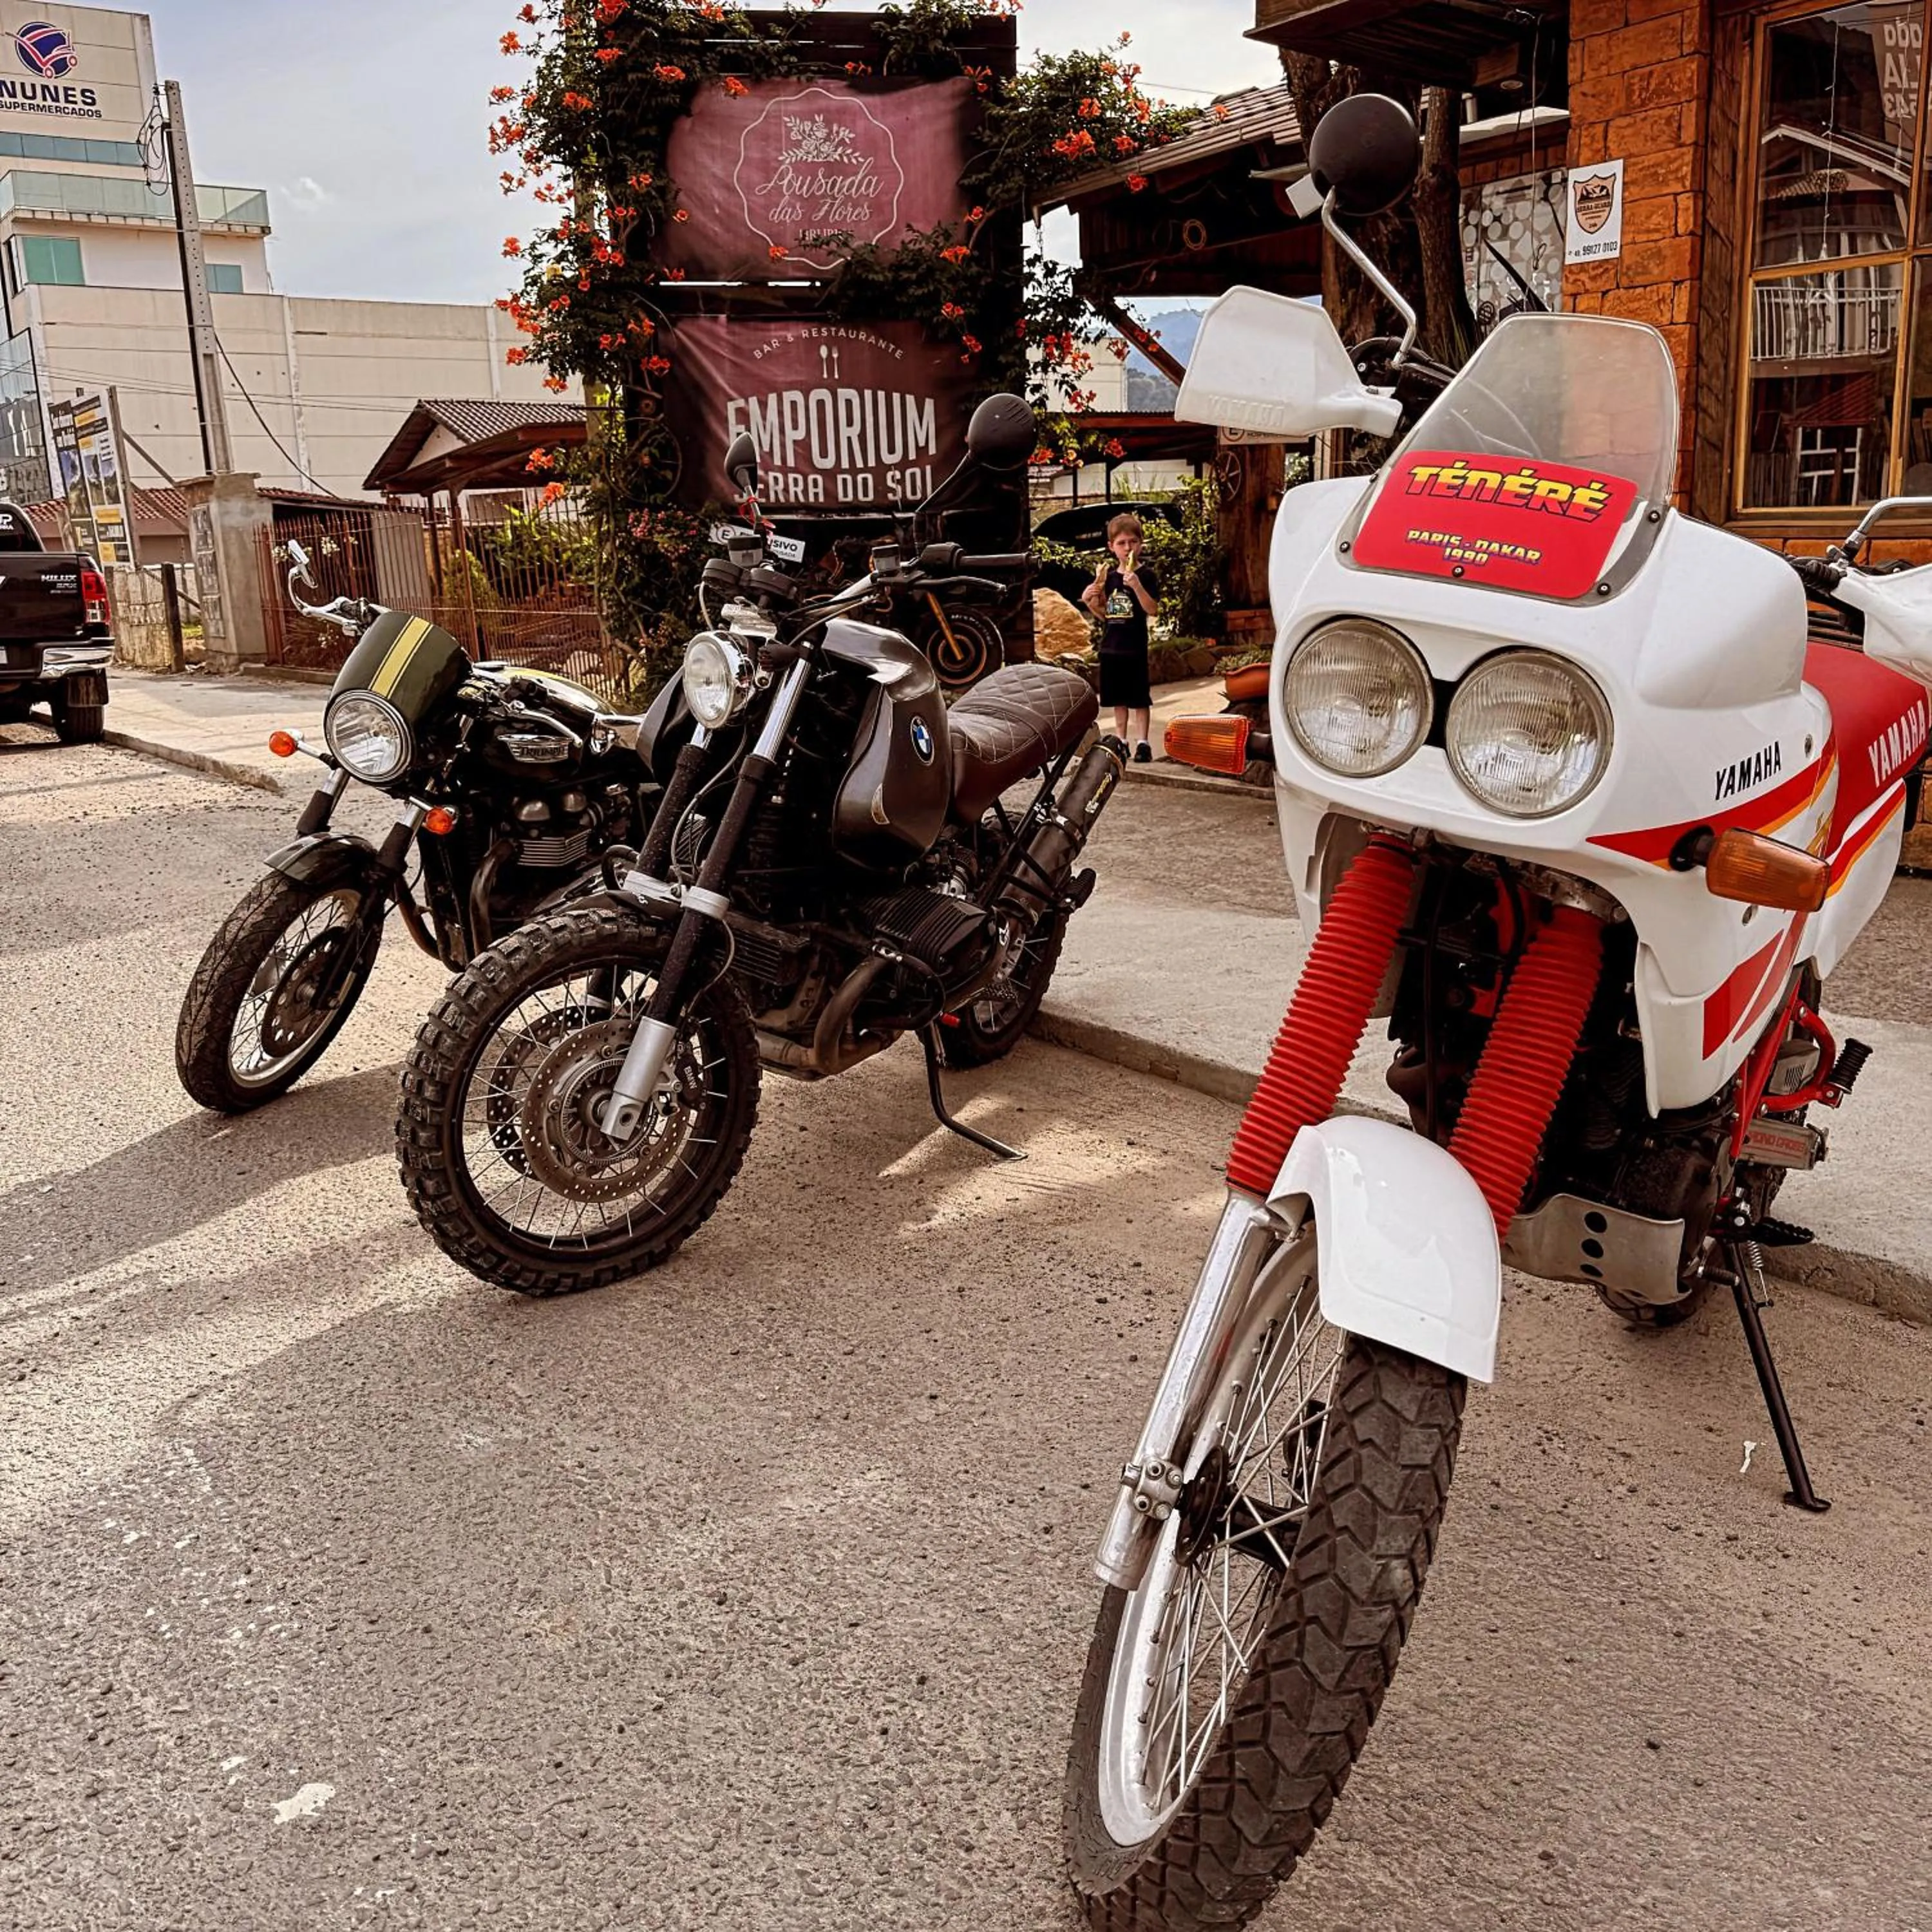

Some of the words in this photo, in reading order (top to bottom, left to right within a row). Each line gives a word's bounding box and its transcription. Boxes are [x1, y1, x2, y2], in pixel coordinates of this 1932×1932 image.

[0, 79, 97, 106] NUNES
[0, 100, 102, 118] SUPERMERCADOS
[755, 157, 884, 198] Pousada
[769, 195, 804, 223] das
[811, 195, 873, 223] Flores
[753, 339, 781, 359] BAR
[802, 327, 904, 359] RESTAURANTE
[727, 388, 936, 469] EMPORIUM
[837, 473, 875, 503] DO
[1406, 528, 1463, 548] PARIS
[1474, 538, 1542, 565] DAKAR
[1443, 546, 1489, 566] 1990
[1868, 699, 1926, 788] YAMAHA
[1715, 741, 1782, 800] YAMAHA
